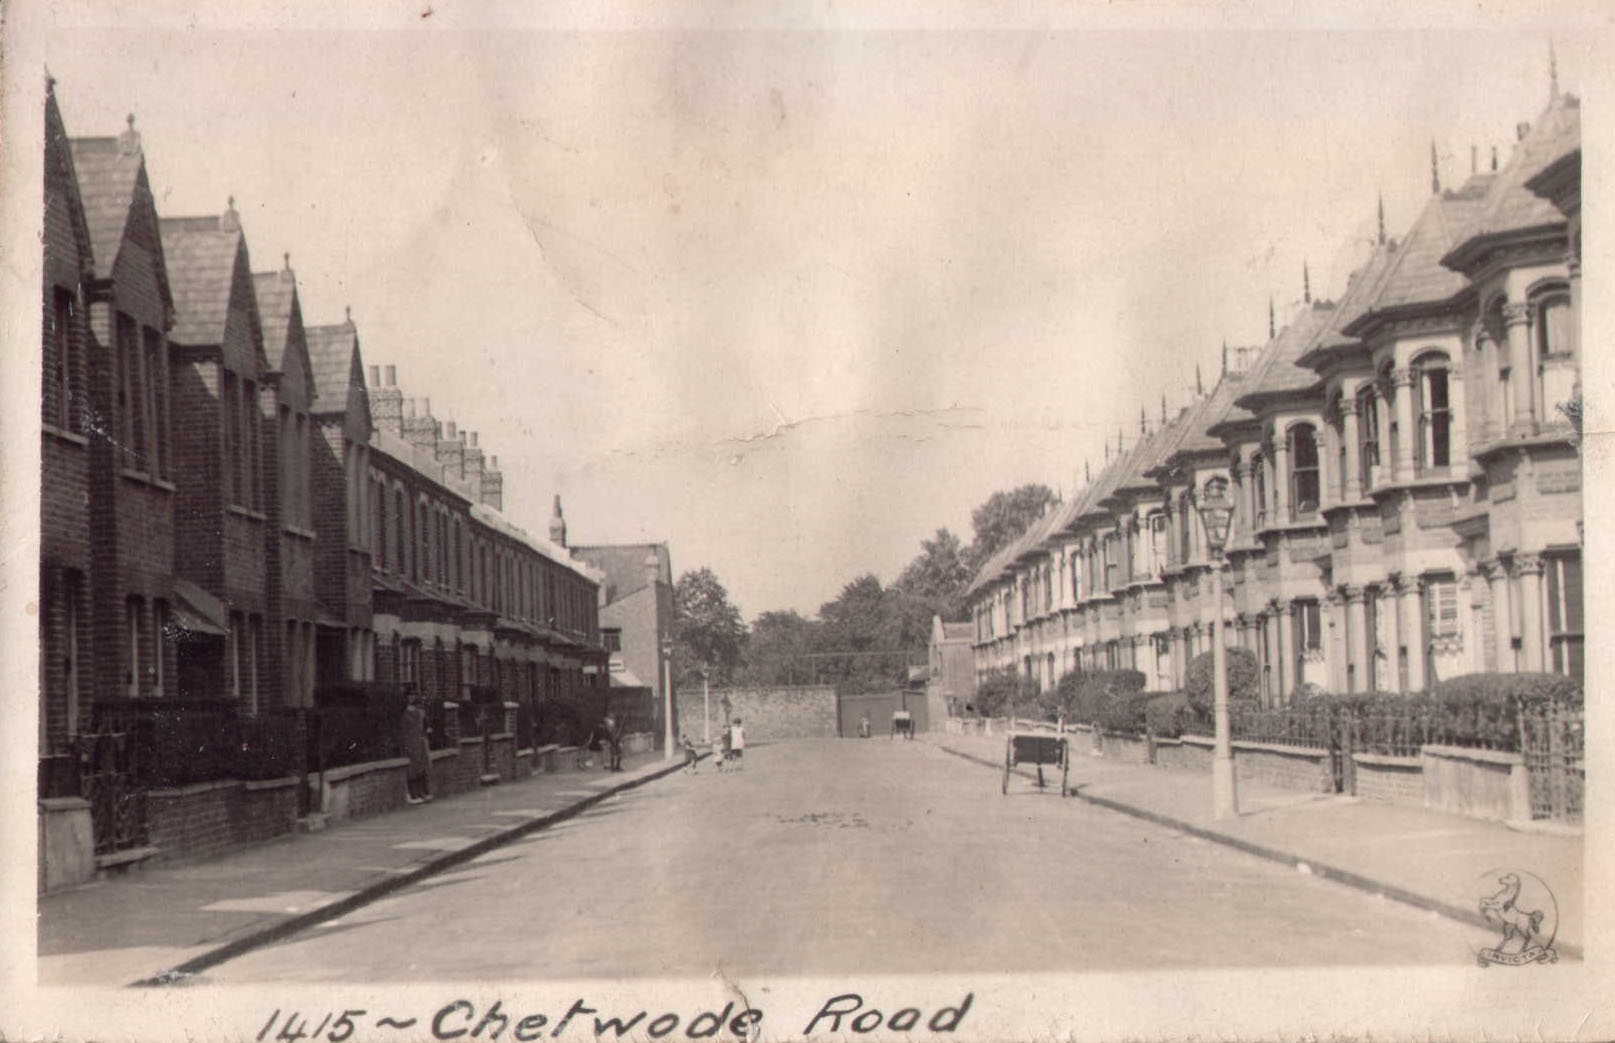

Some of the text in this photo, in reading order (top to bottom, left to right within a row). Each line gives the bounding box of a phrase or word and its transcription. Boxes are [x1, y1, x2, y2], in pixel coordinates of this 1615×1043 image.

[256, 1009, 367, 1043] 1415
[432, 999, 763, 1041] Chetwode
[803, 992, 974, 1035] Road
